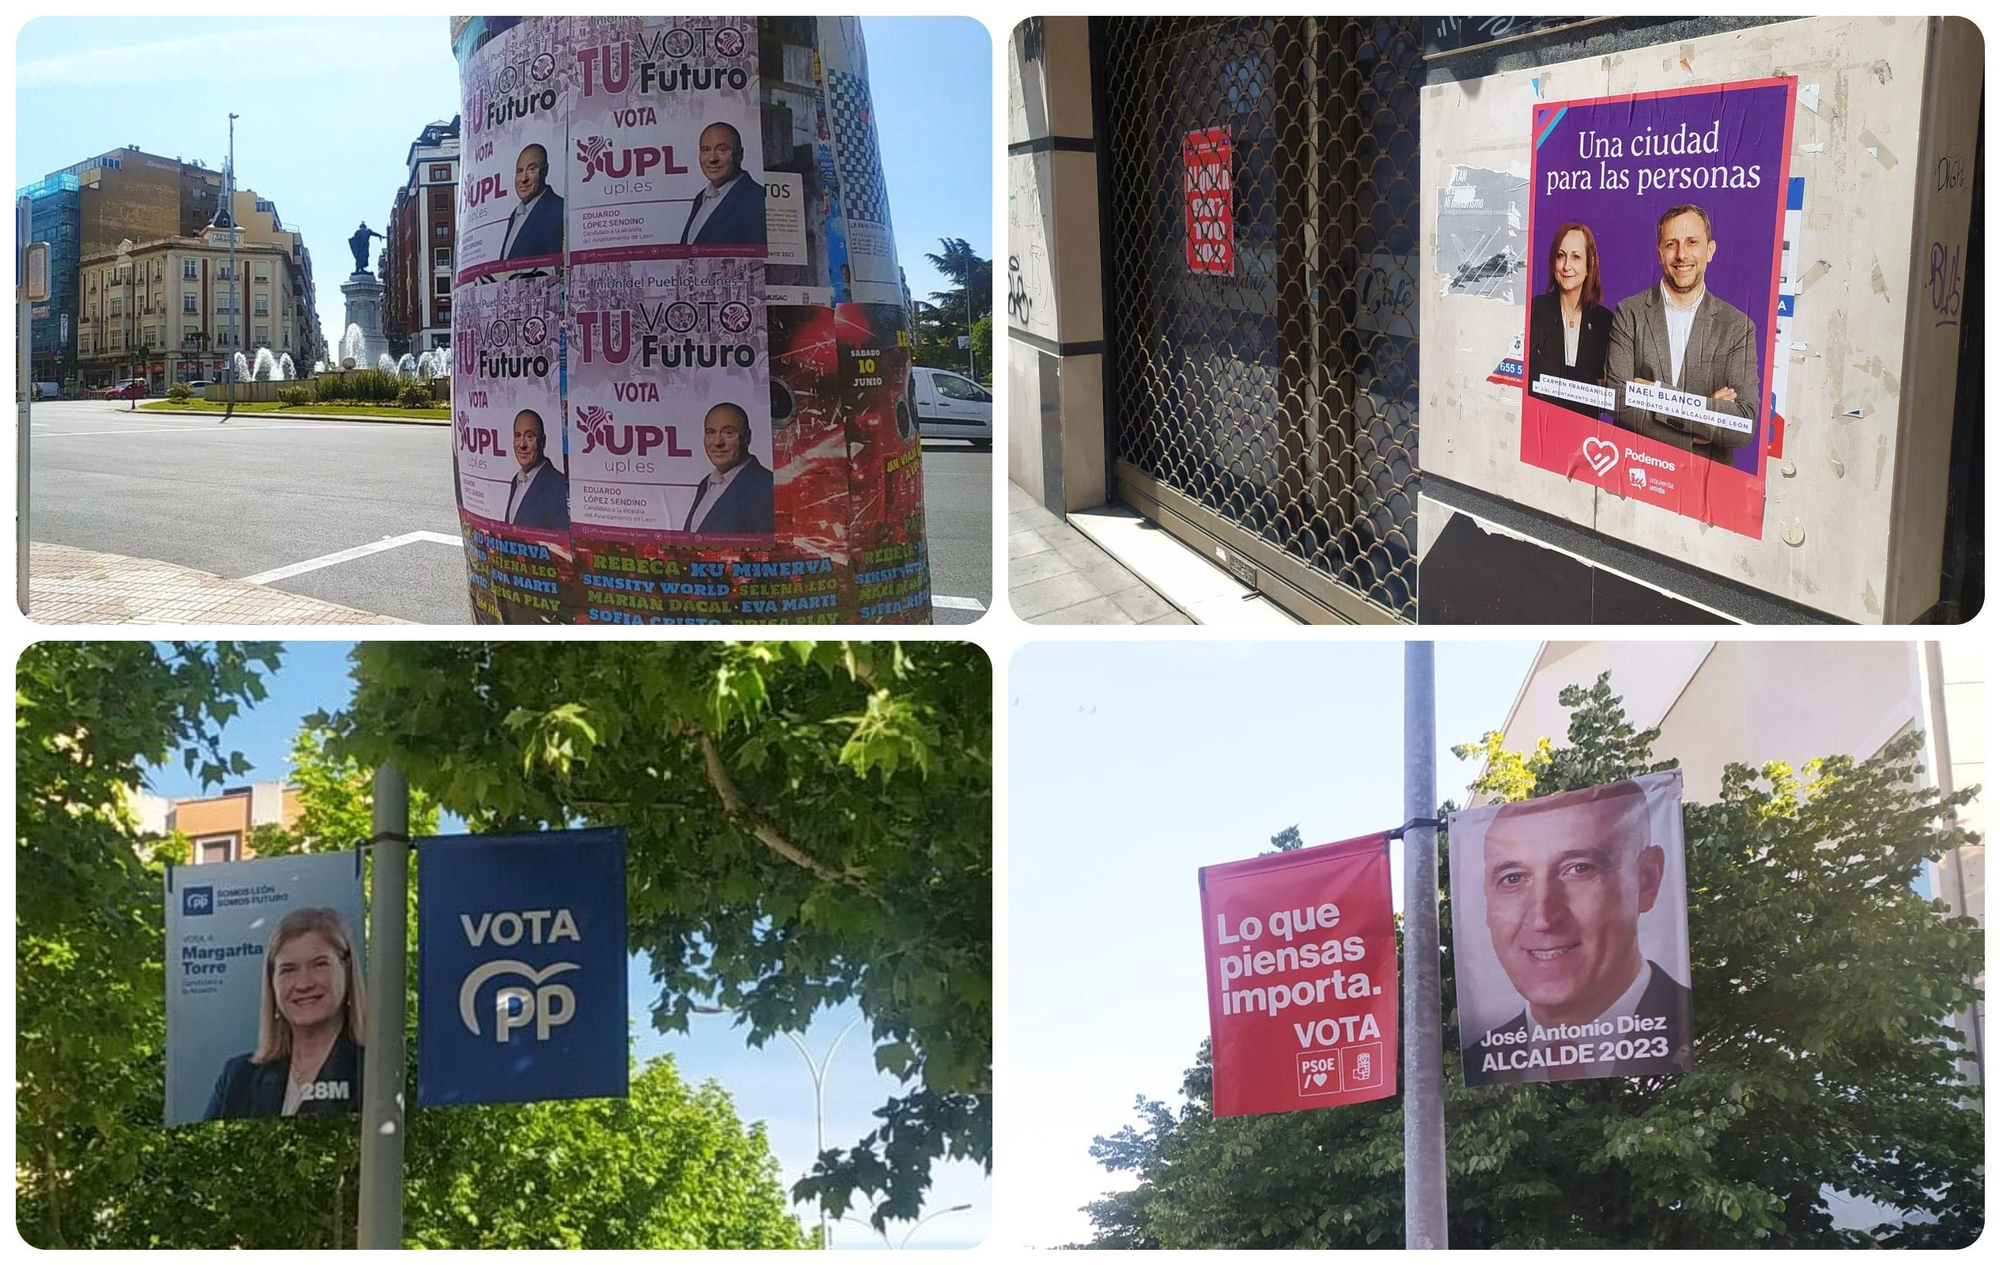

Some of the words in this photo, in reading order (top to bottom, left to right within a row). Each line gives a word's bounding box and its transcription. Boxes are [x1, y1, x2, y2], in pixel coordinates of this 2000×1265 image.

[577, 41, 630, 97] TU
[638, 27, 744, 61] VOTO
[641, 62, 748, 93] Futuro
[467, 88, 484, 139] TU
[487, 53, 555, 99] VOTO
[487, 89, 556, 130] Futuro
[613, 107, 657, 129] VOTA
[1579, 130, 1623, 159] Una
[1631, 120, 1719, 158] ciudad
[474, 141, 493, 163] VOTA
[603, 145, 688, 179] UPL
[603, 181, 652, 197] upl.es
[1546, 168, 1591, 195] para
[1600, 160, 1629, 191] las
[1637, 163, 1761, 196] personas
[469, 173, 507, 208] UPL
[582, 210, 620, 220] EDUARDO
[1193, 198, 1224, 218] 987
[582, 221, 607, 229] LÓPEZ
[608, 217, 645, 227] SENDINO
[1194, 244, 1226, 263] 102
[626, 277, 644, 288] del
[648, 276, 691, 287] Pueblo
[577, 310, 630, 364] TU
[639, 301, 752, 334] VOTO
[458, 329, 475, 376] TU
[478, 316, 547, 349] VOTO
[642, 334, 755, 368] Futuro
[480, 350, 549, 379] Futuro
[858, 359, 876, 374] 10
[1500, 362, 1515, 373] 655
[614, 383, 660, 402] VOTA
[853, 377, 883, 388] JUNIO
[1543, 377, 1567, 388] CARMEN
[1569, 383, 1613, 397] FRANGANILLO
[469, 391, 488, 409] VOTA
[1552, 390, 1589, 402] AYUNTAMIENTO
[1598, 400, 1612, 408] LEÓN
[1629, 386, 1654, 398] NAEL
[1658, 391, 1702, 408] BLANCO
[1628, 398, 1663, 410] CANDIDATO
[1682, 410, 1715, 422] ALCALDÍA
[1728, 419, 1749, 430] LEÓN
[465, 426, 507, 457] UPL
[603, 425, 692, 458] UPL
[604, 458, 655, 475] upl.es
[1625, 447, 1676, 472] Podemos
[583, 486, 621, 495] EDUARDO
[1649, 477, 1675, 490] izquierda
[1649, 485, 1666, 495] unida
[584, 495, 608, 504] LÓPEZ
[610, 498, 647, 507] SENDINO
[584, 504, 611, 512] Candidato
[486, 535, 551, 561] MINERVA
[531, 564, 557, 579] LEO
[593, 554, 681, 576] REBECA
[690, 562, 724, 577] KU
[732, 557, 832, 578] MINERVA
[513, 575, 558, 594] MARTI
[583, 574, 655, 594] SENSITY
[660, 580, 730, 597] WORLD
[739, 582, 804, 597] SELENA
[809, 578, 838, 592] LEO
[523, 594, 561, 612] PLAY
[587, 590, 664, 612] MARIAN
[669, 599, 731, 614] DACAL
[741, 600, 778, 613] EVA
[782, 594, 837, 612] MARTI
[589, 608, 644, 625] SOFIA
[217, 888, 249, 898] SOMOS
[217, 897, 250, 907] SOMOS
[252, 893, 288, 904] FUTURO
[460, 908, 581, 947] VOTA
[1217, 912, 1263, 945] Lo
[1268, 902, 1341, 942] que
[182, 942, 264, 960] Margarita
[1220, 936, 1366, 980] piensas
[182, 961, 226, 975] Torre
[1223, 969, 1381, 1016] importa.
[1294, 1013, 1380, 1048] VOTA
[1480, 1026, 1527, 1048] José
[1531, 1019, 1614, 1042] Antonio
[1617, 1014, 1667, 1034] Diez
[1481, 1046, 1595, 1073] ALCALDE
[1599, 1037, 1669, 1062] 2023
[1302, 1060, 1336, 1075] PSOE
[300, 1081, 350, 1100] 28M
